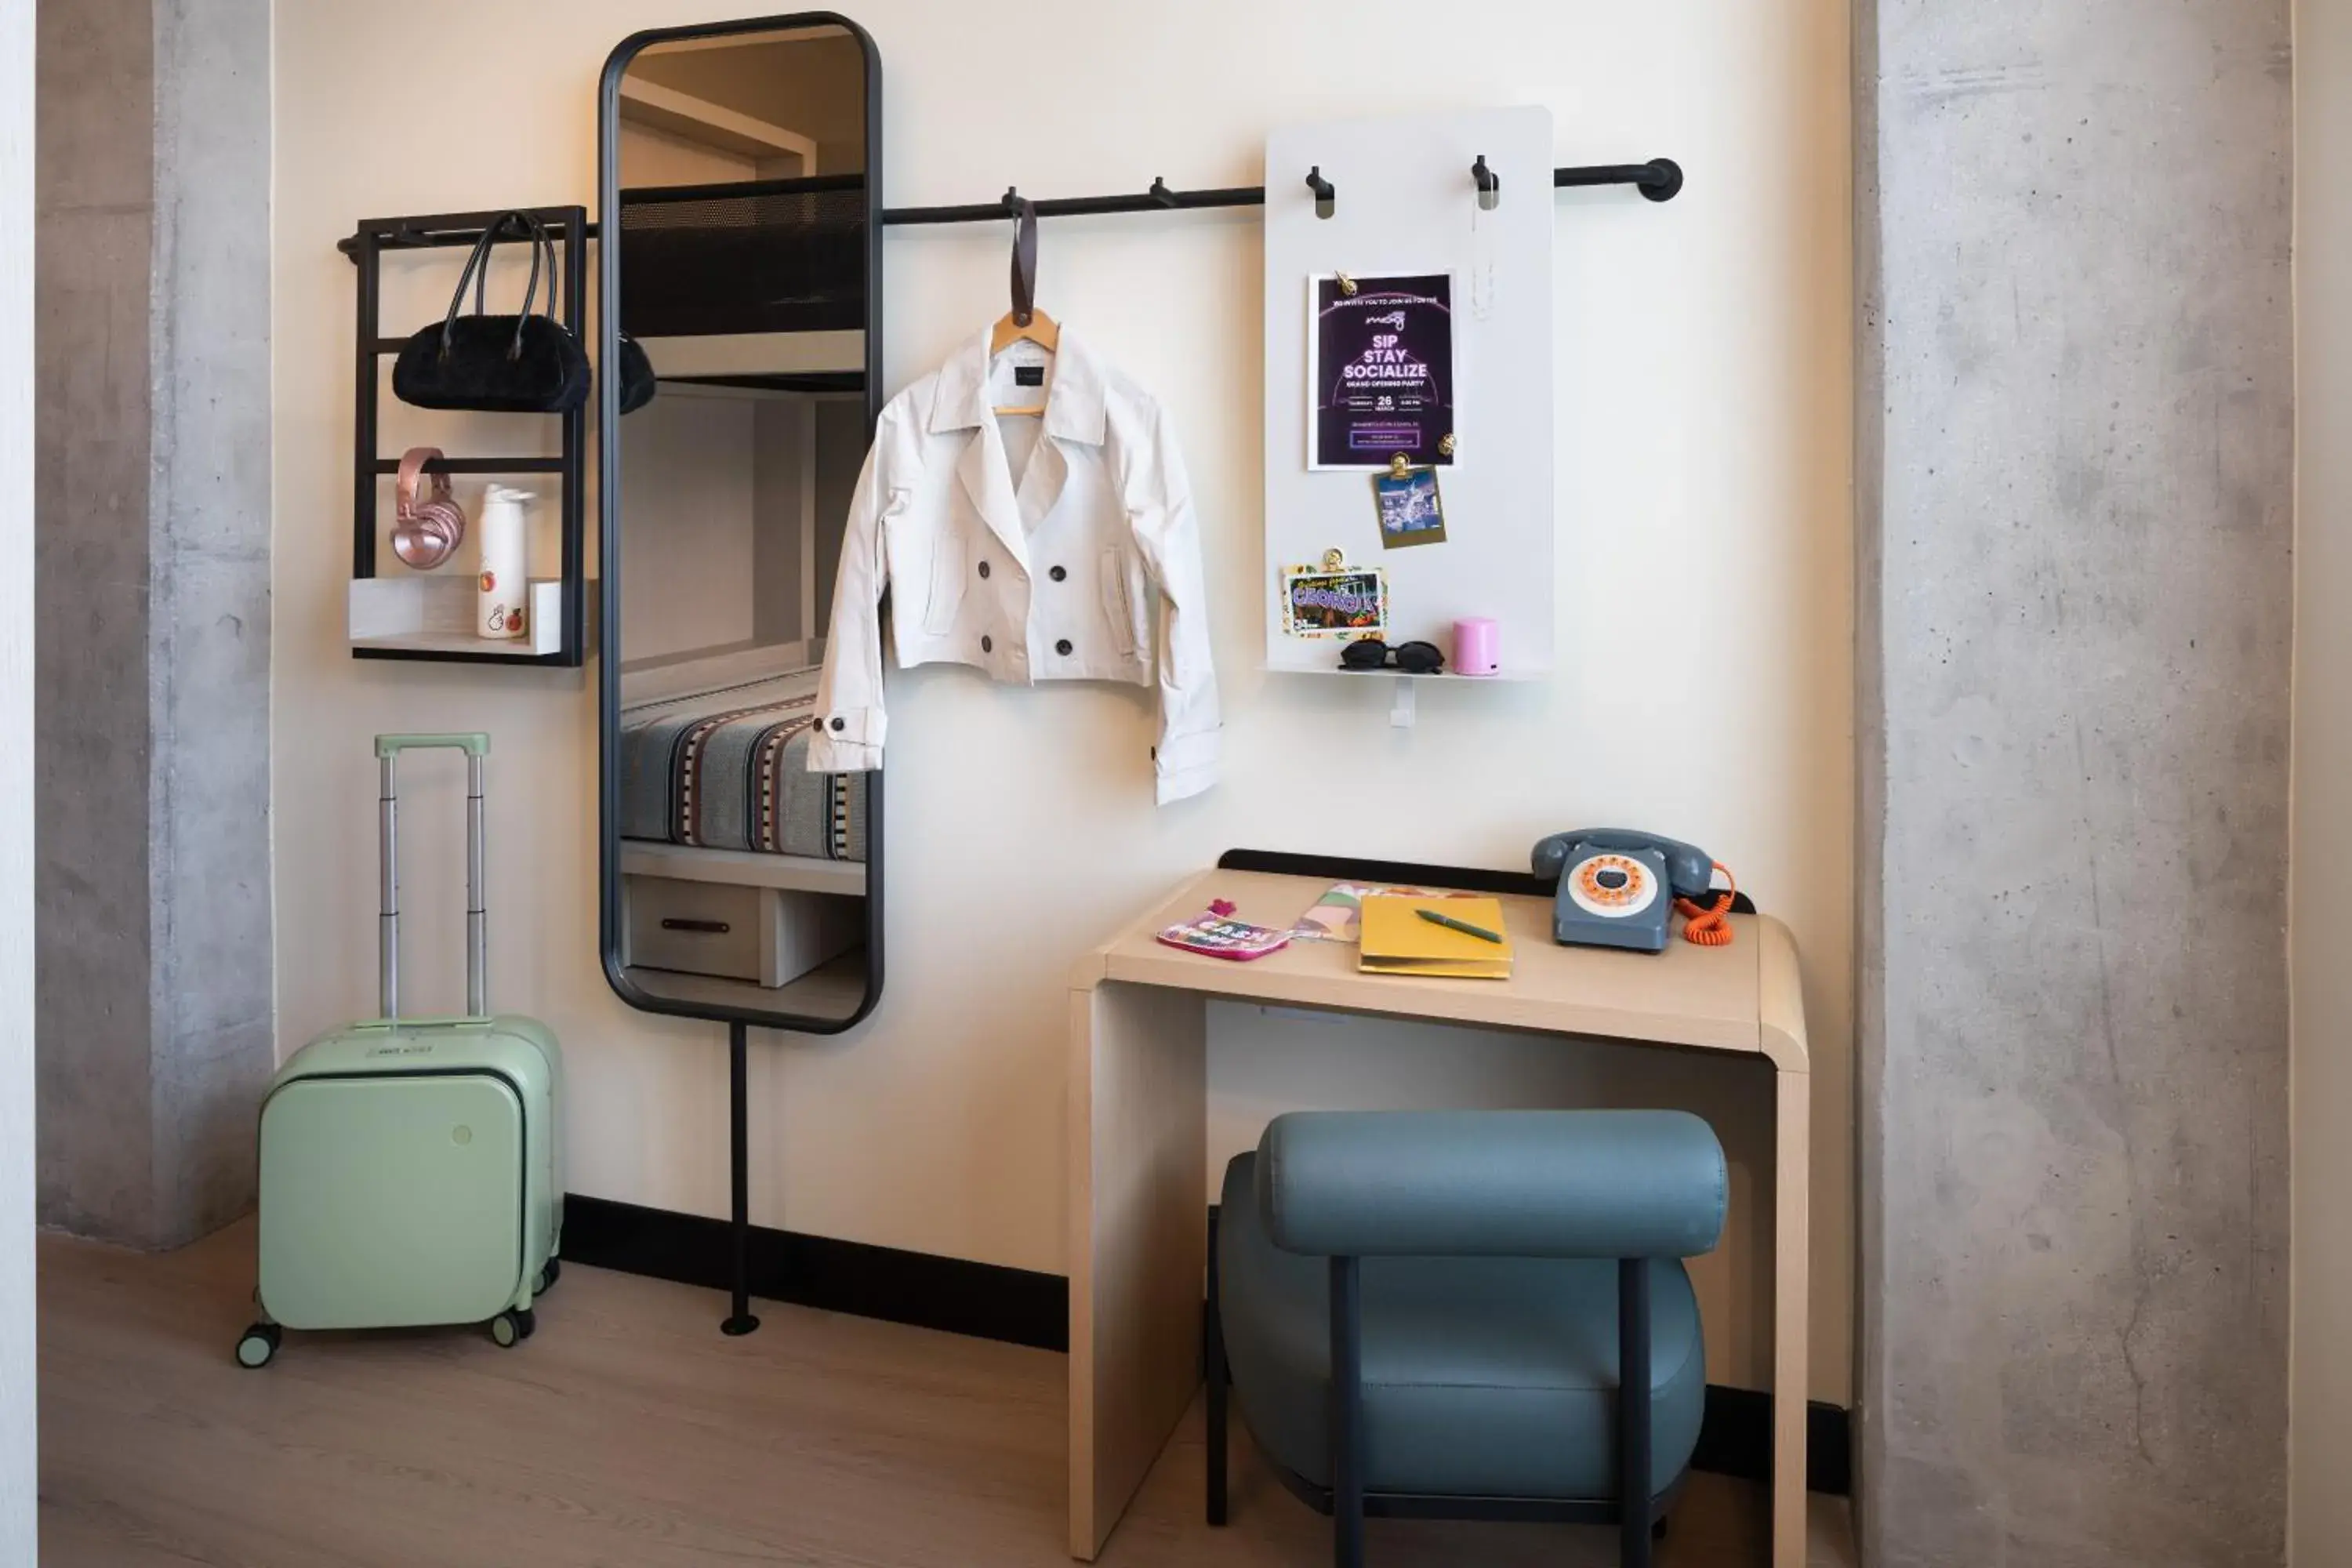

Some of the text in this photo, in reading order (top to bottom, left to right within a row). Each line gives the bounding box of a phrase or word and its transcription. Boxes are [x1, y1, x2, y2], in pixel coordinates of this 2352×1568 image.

[1373, 335, 1398, 348] SIP
[1364, 349, 1407, 363] STAY
[1344, 364, 1427, 378] SOCIALIZE
